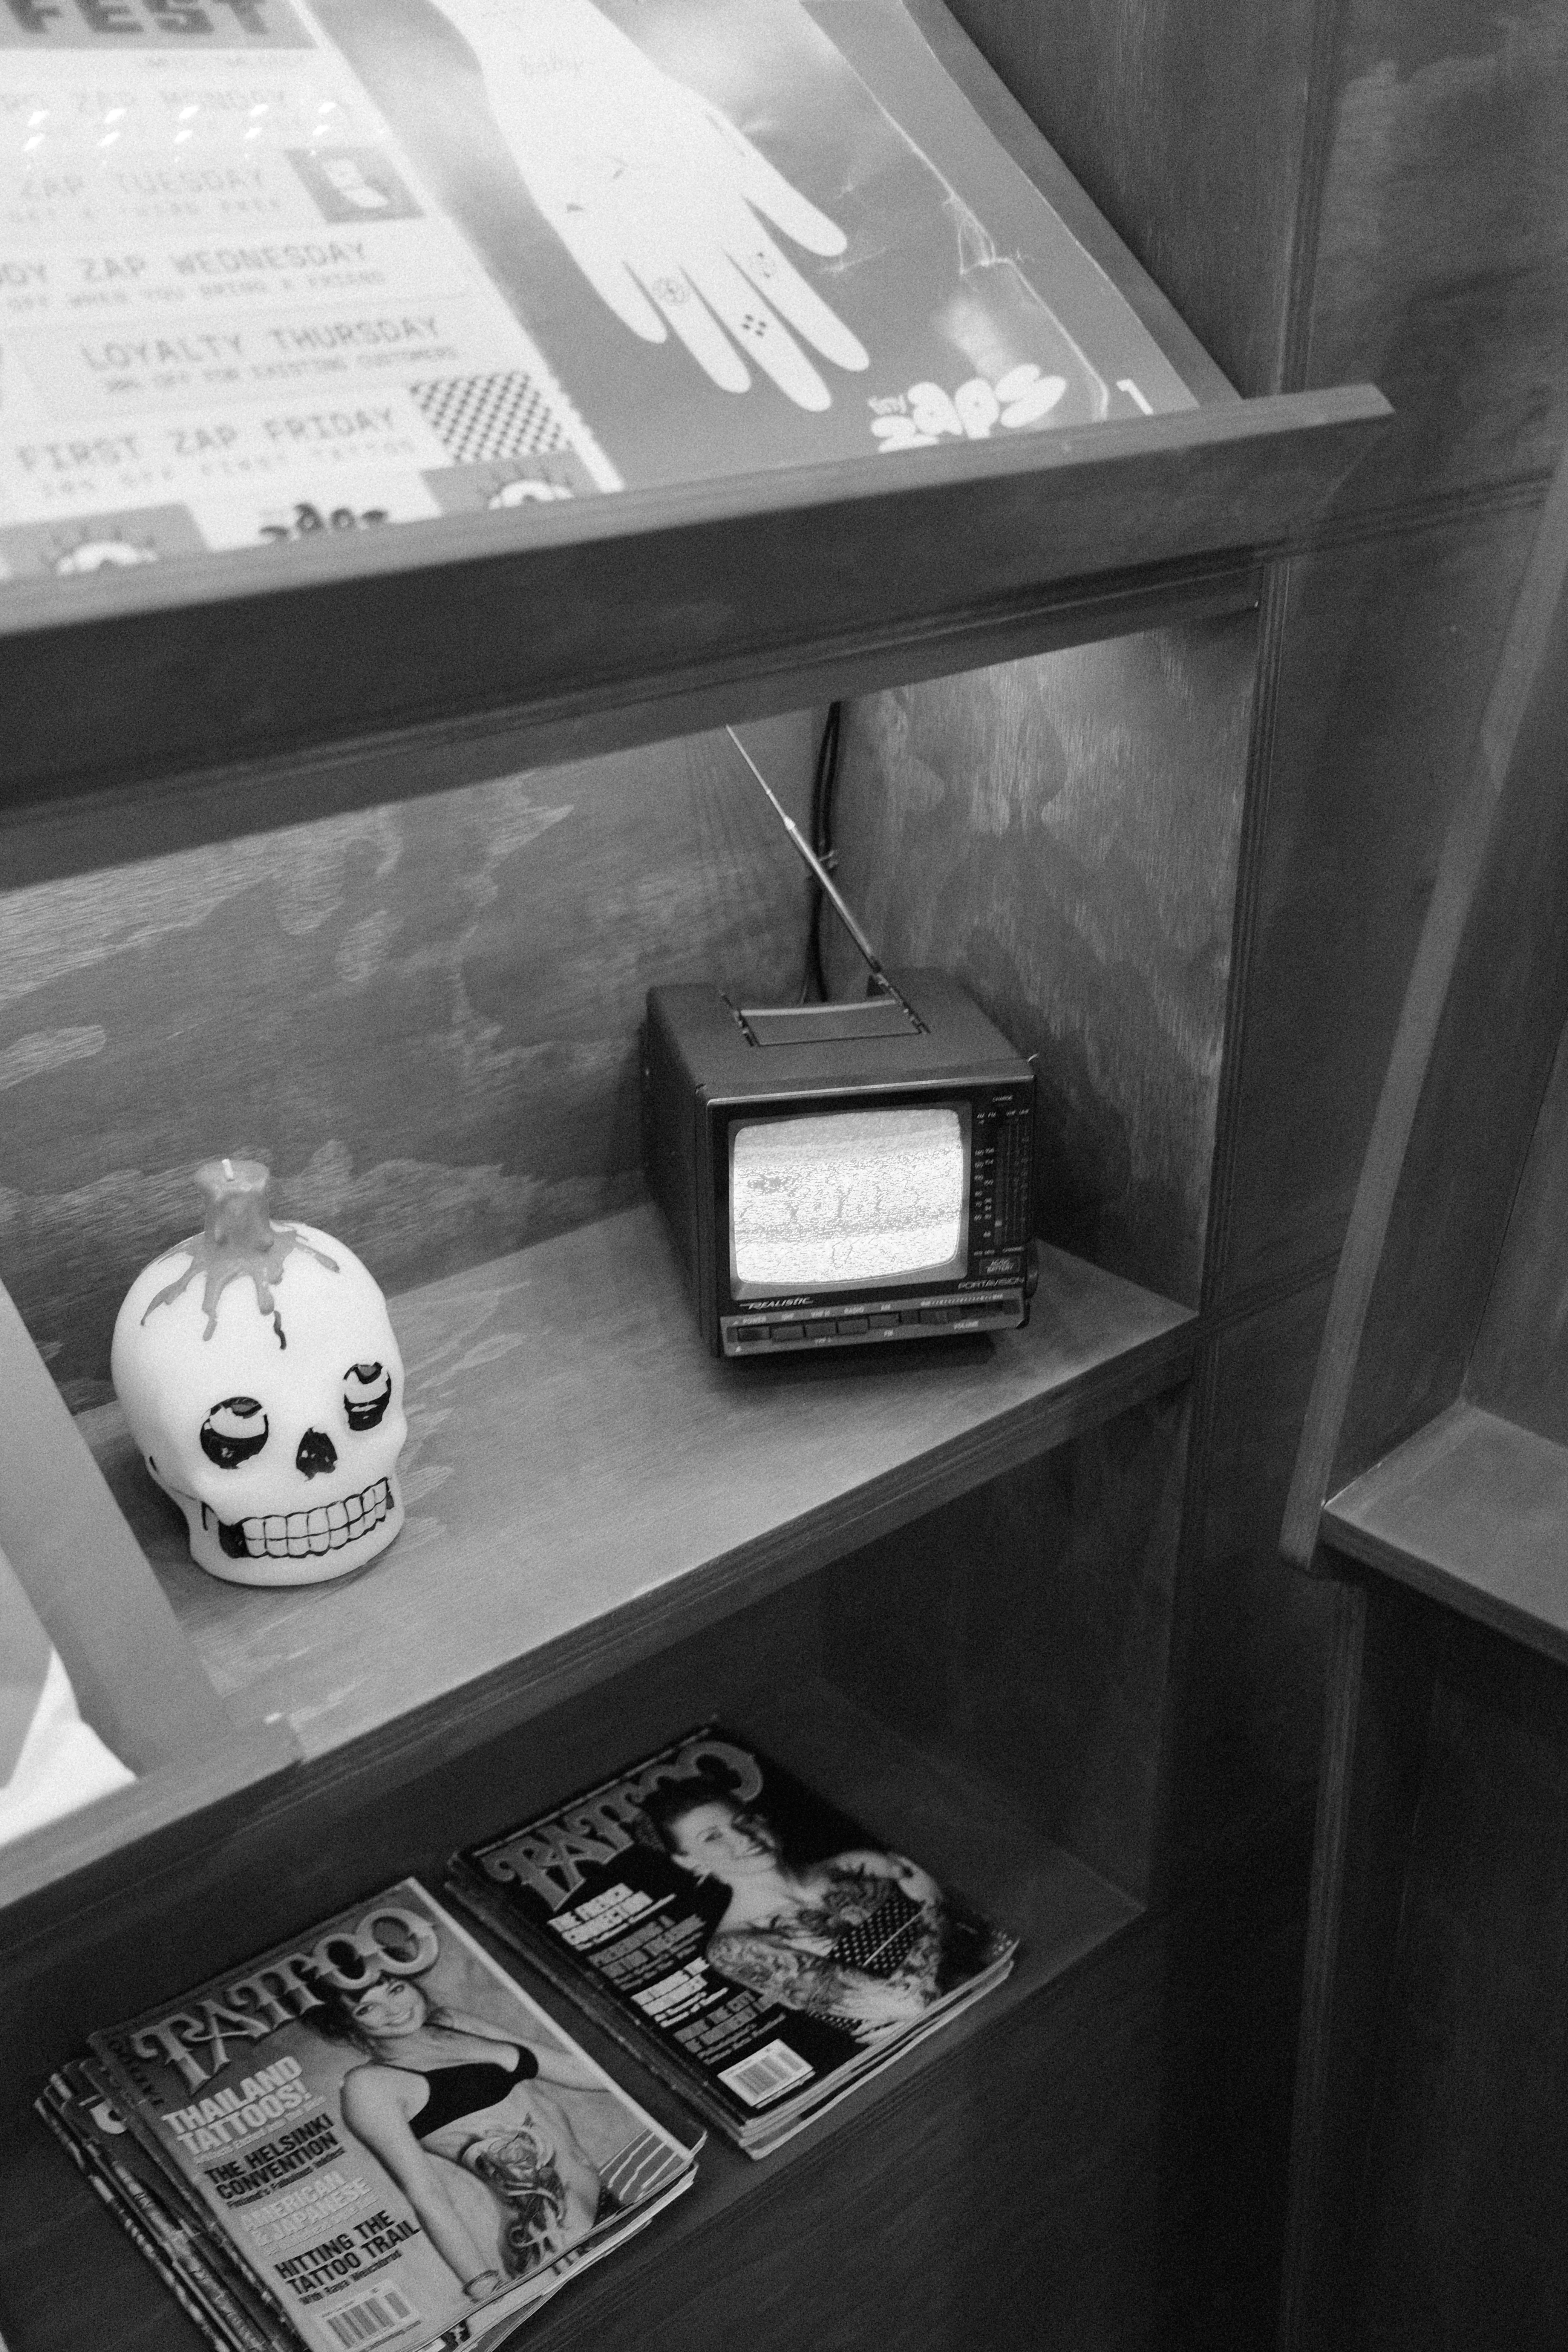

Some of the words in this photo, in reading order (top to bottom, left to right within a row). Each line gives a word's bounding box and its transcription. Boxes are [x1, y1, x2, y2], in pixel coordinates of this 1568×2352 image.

[115, 168, 264, 195] TUESDAY
[77, 255, 147, 283] ZAP
[170, 241, 368, 277] WEDNESDAY
[80, 331, 243, 372] LOYALTY
[268, 315, 440, 353] THURSDAY
[17, 434, 142, 473] FIRST
[165, 424, 237, 457] ZAP
[263, 407, 397, 443] FRIDAY
[131, 1907, 438, 2094] TATTOO
[161, 2056, 302, 2135] THAILAND
[177, 2078, 312, 2155] TATTOOS!
[204, 2161, 247, 2184] THE
[244, 2113, 334, 2170] HELSINKI
[216, 2132, 338, 2199] CONVENTION
[240, 2168, 347, 2233] AMERICAN
[269, 2176, 372, 2242] JAPANESE
[274, 2234, 356, 2279] HITTING
[353, 2210, 396, 2240] THE
[286, 2252, 361, 2294] TATTOO
[361, 2220, 422, 2258] TRAIL
